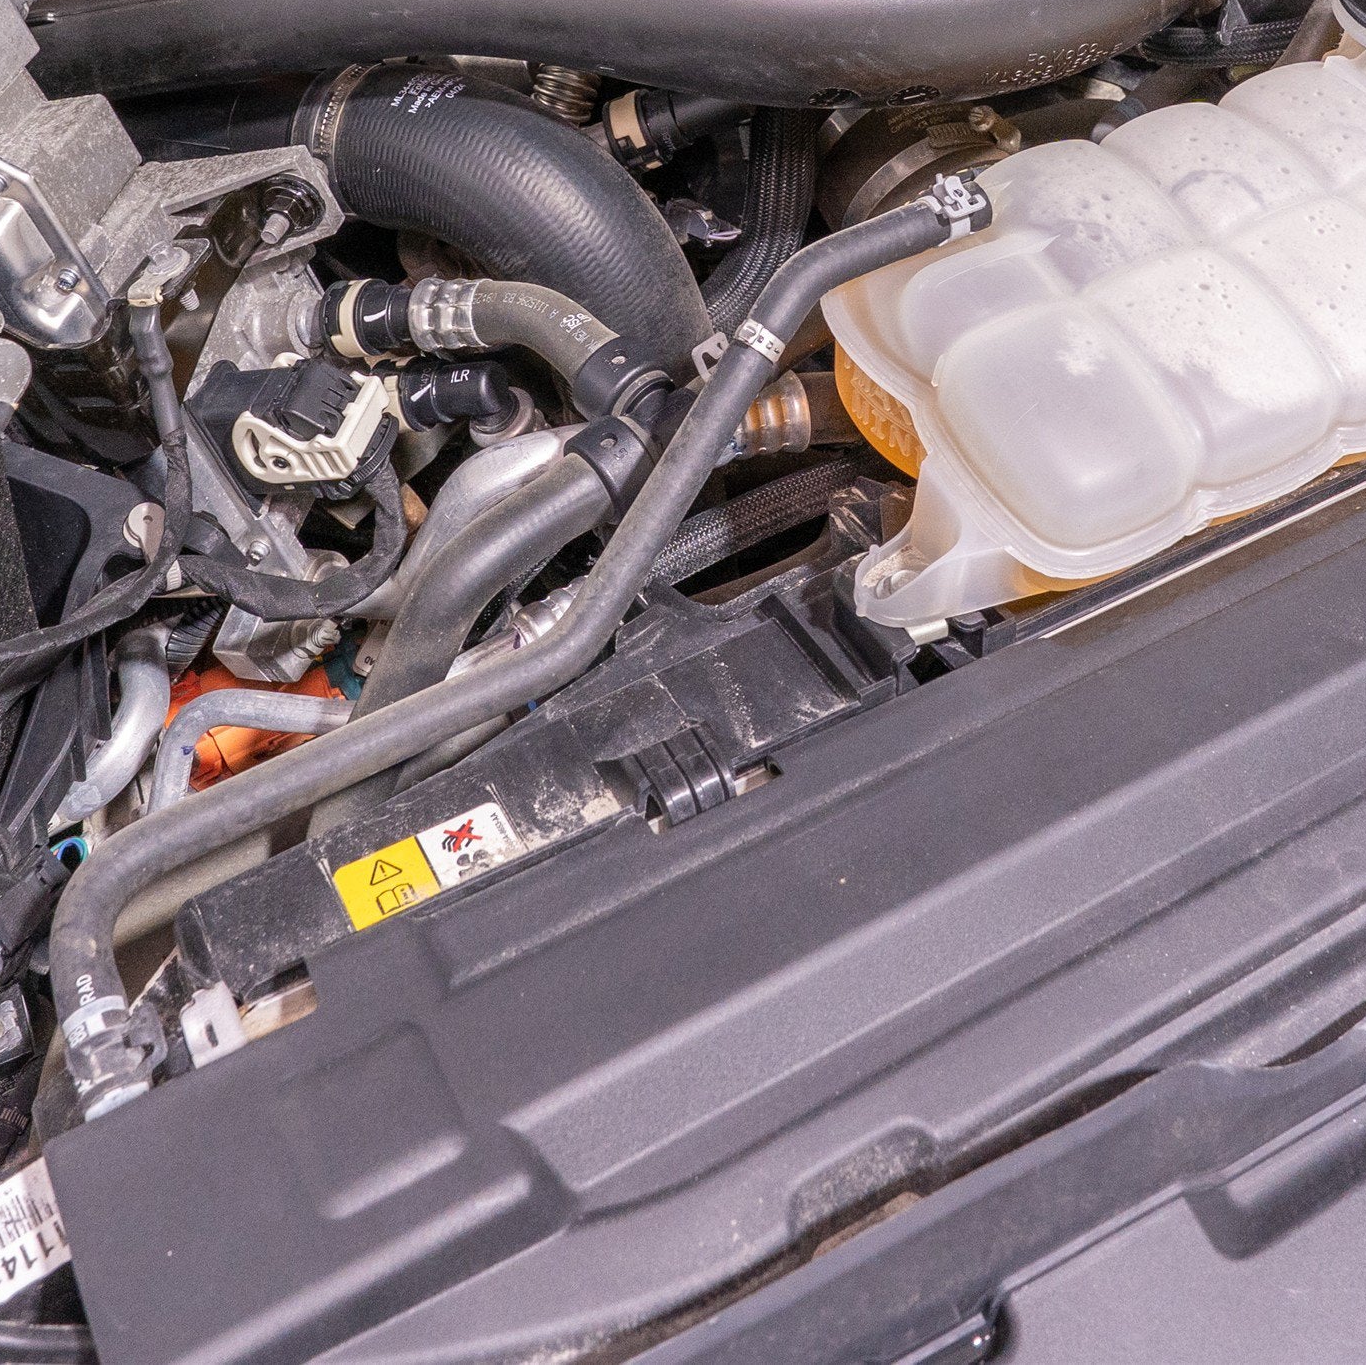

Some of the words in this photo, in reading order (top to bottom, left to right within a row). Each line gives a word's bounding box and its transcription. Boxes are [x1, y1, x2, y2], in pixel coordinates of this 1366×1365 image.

[408, 92, 428, 114] Made
[450, 369, 471, 384] ILR
[76, 974, 96, 1007] RAD
